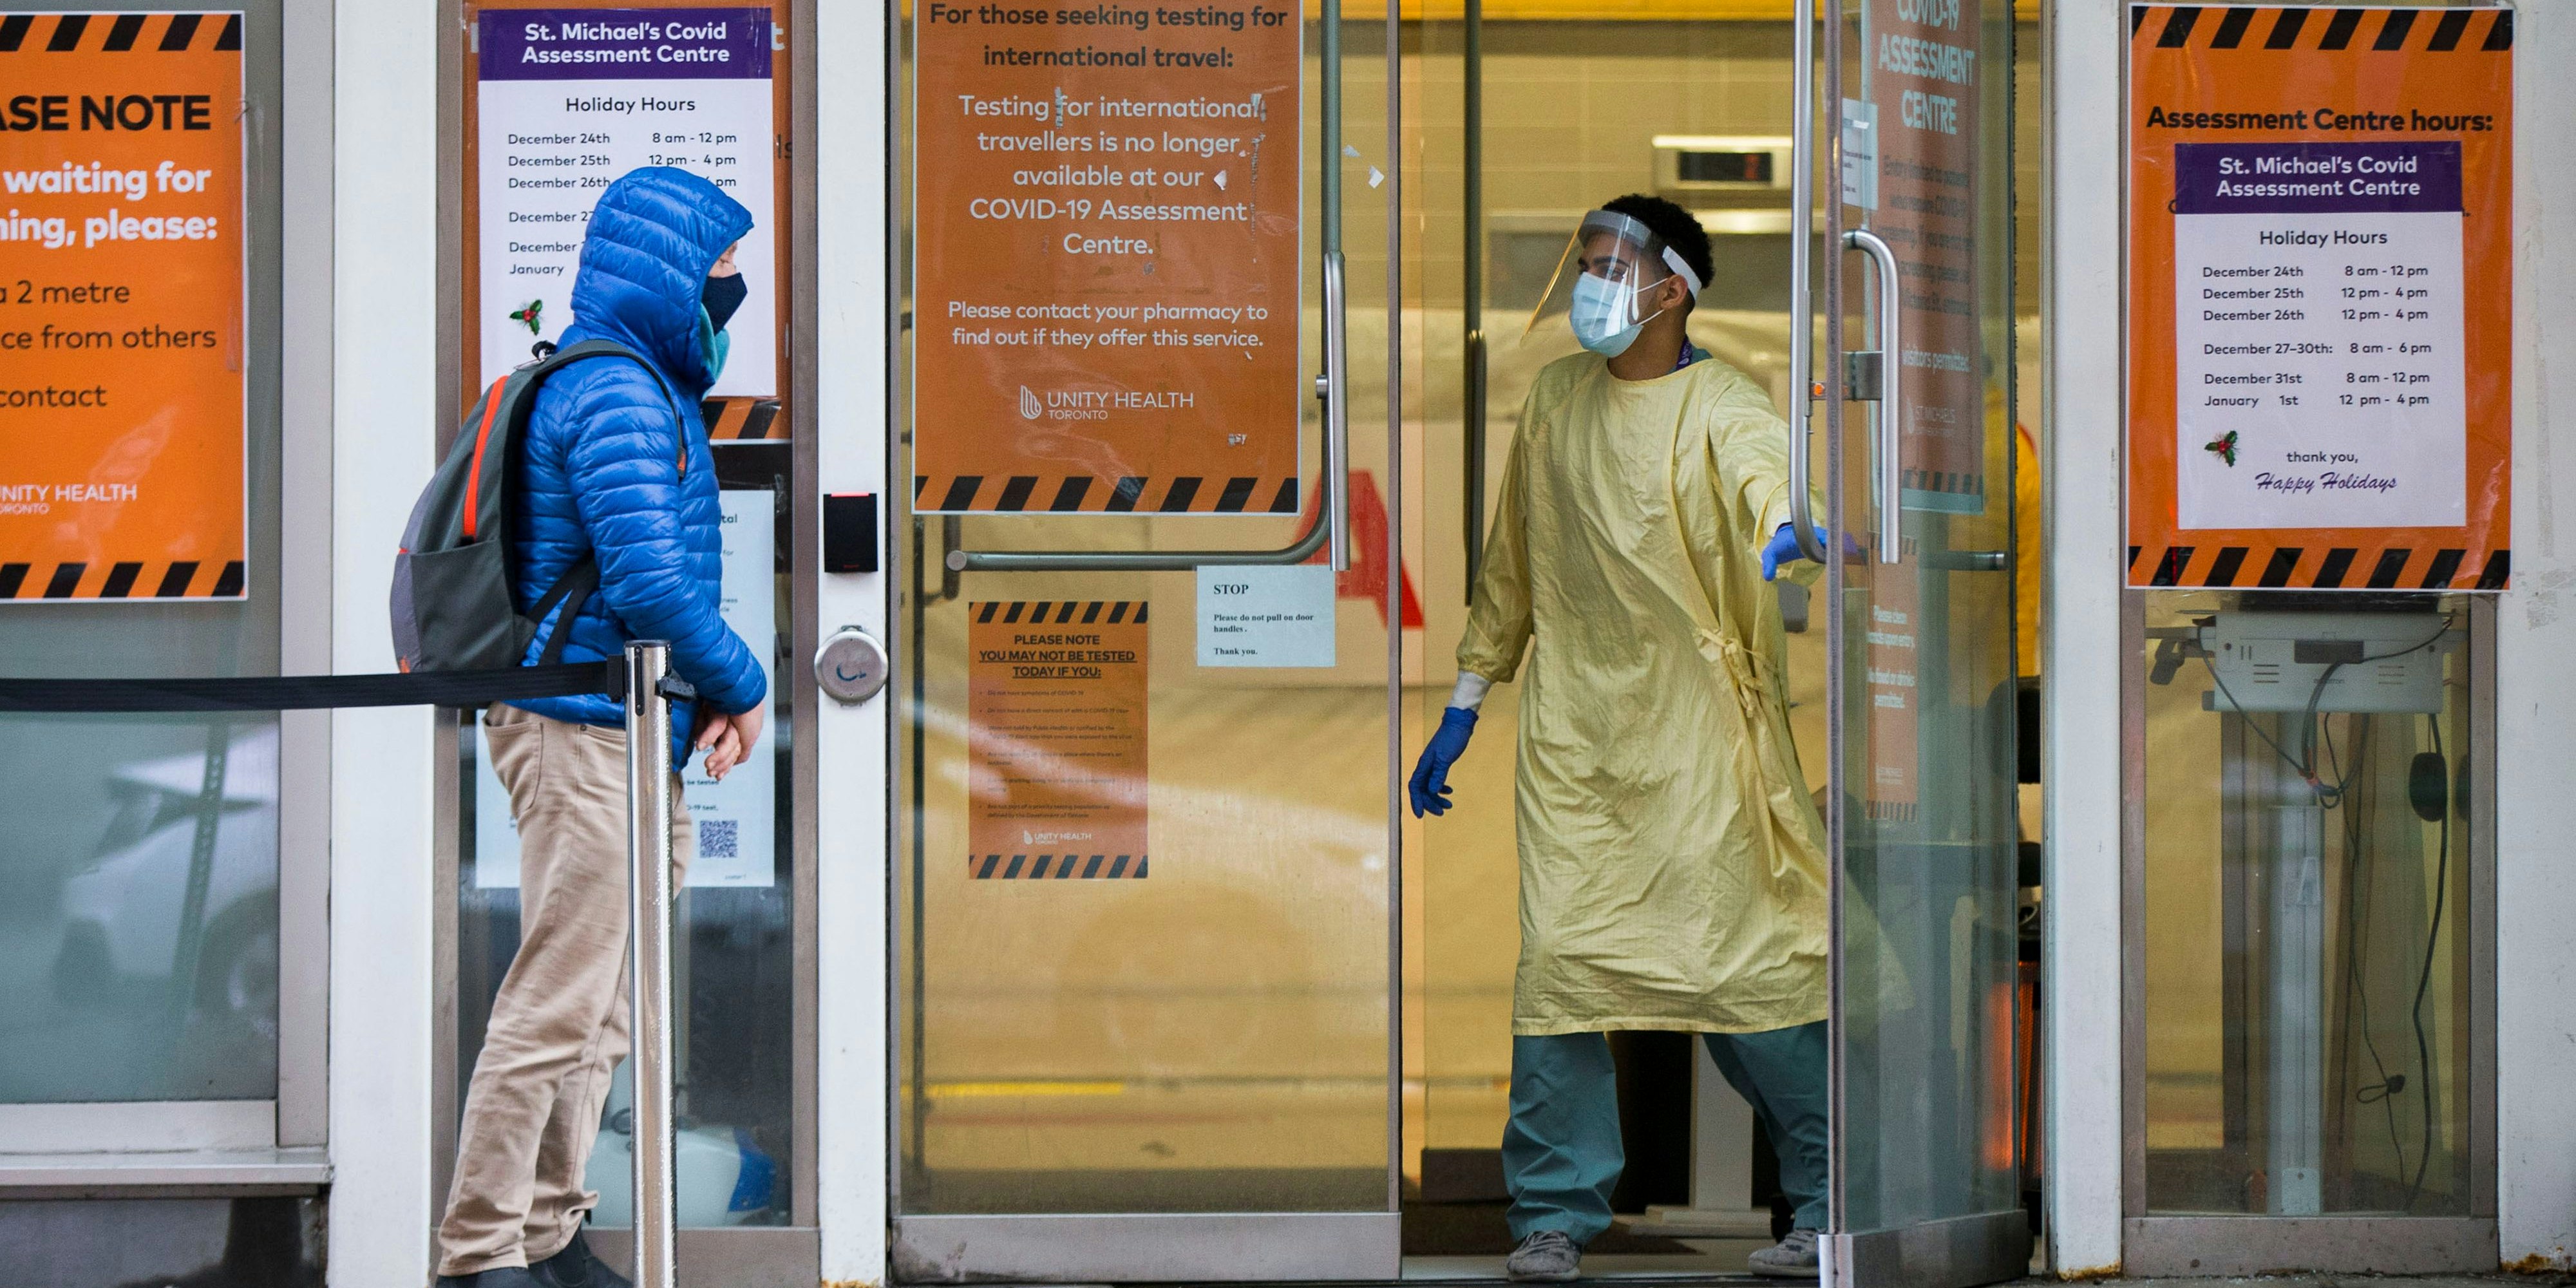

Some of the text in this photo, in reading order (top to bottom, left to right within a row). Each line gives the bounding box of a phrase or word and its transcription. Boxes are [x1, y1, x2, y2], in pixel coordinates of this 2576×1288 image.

[931, 3, 1287, 31] For those seeking testing for
[1897, 0, 1960, 31] COVID-19
[526, 22, 726, 41] St. Michael's Covid
[522, 45, 730, 63] Assessment Centre
[985, 44, 1233, 67] international travel:
[1878, 33, 1976, 86] ASSESSMENT
[81, 95, 211, 131] NOTE
[567, 97, 695, 115] Holiday Hours
[959, 95, 1260, 121] Testing for international
[1901, 90, 1957, 135] CENTRE
[2146, 106, 2493, 131] Assessment Centre hours:
[509, 133, 610, 144] December 24th
[653, 133, 660, 143] 8
[699, 133, 712, 142] 12
[716, 135, 736, 145] pm
[978, 130, 1240, 155] travellers is no longer
[509, 155, 610, 166] December 25th
[649, 155, 735, 167] 12 pm 4 pm
[2220, 156, 2416, 174] St. Michael's Covid
[3, 161, 211, 201] waiting for
[509, 177, 609, 188] December 26th
[1014, 165, 1204, 186] available at our
[2217, 179, 2420, 196] Assessment Centre
[971, 198, 1247, 220] COVID-19 Assessment
[509, 212, 576, 222] December
[86, 209, 217, 248] please:
[509, 242, 576, 252] December
[1064, 233, 1153, 254] Centre.
[2260, 231, 2387, 248] Holiday Hours
[510, 264, 564, 276] January
[2203, 267, 2303, 277] December 24th
[2345, 265, 2353, 276] 8
[2391, 265, 2403, 276] 12
[2408, 268, 2428, 278] pm
[17, 280, 32, 303] 2
[43, 283, 129, 303] metre
[2204, 288, 2304, 299] December 25th
[2342, 287, 2427, 300] 12 pm 4 pm
[949, 301, 1267, 323] Please contact your pharmacy to
[2204, 309, 2304, 321] December 26th
[2342, 309, 2428, 322] 12 pm 4 pm
[41, 325, 112, 348] from
[122, 325, 216, 348] others
[952, 327, 1263, 349] find out if they offer this service.
[2204, 344, 2271, 354] December
[2351, 343, 2358, 353] 8
[2400, 343, 2407, 353] 6
[2411, 345, 2431, 355] pm
[2205, 374, 2302, 384] December 31st
[2347, 373, 2354, 383] 8
[2392, 372, 2405, 383] 12
[2410, 375, 2429, 385] pm
[1048, 392, 1193, 408] UNITY HEALTH
[2205, 395, 2298, 408] January 1st
[2340, 393, 2429, 407] 12 pm 4 pm
[1048, 410, 1108, 419] TORONTO
[2287, 451, 2358, 464] thank you,
[2255, 472, 2396, 494] Happy Holidays
[55, 484, 137, 502] HEALTH
[1214, 585, 1249, 594] STOP
[1267, 614, 1282, 623] pull
[1015, 635, 1099, 645] PLEASE NOTE
[980, 651, 1135, 661] YOU MAY NOT BE TESTED
[1013, 666, 1101, 677] TODAY IF YOU:
